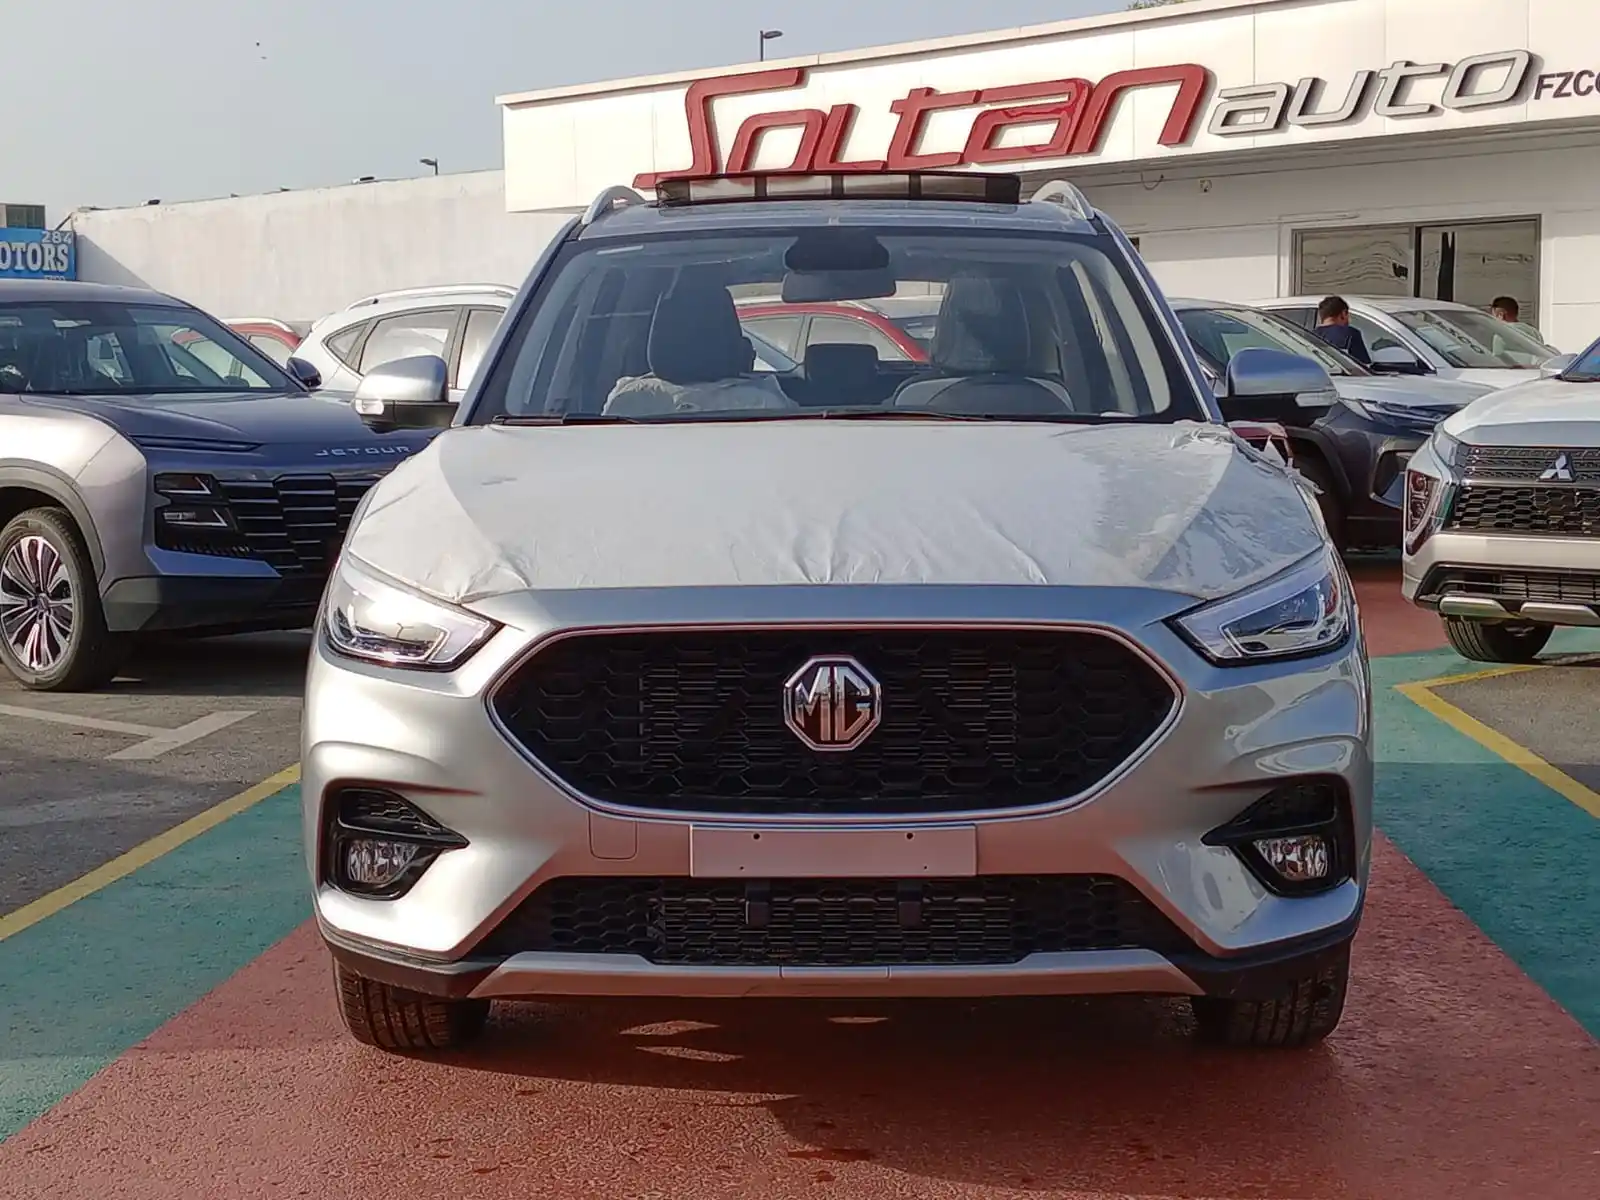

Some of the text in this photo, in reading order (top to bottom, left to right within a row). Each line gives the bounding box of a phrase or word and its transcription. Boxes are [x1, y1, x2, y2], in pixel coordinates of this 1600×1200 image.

[1208, 49, 1533, 135] auto
[1534, 69, 1600, 100] FZC
[41, 230, 72, 244] 284
[0, 241, 68, 272] OTORS
[314, 445, 410, 457] JETOUR
[795, 666, 871, 741] MG
